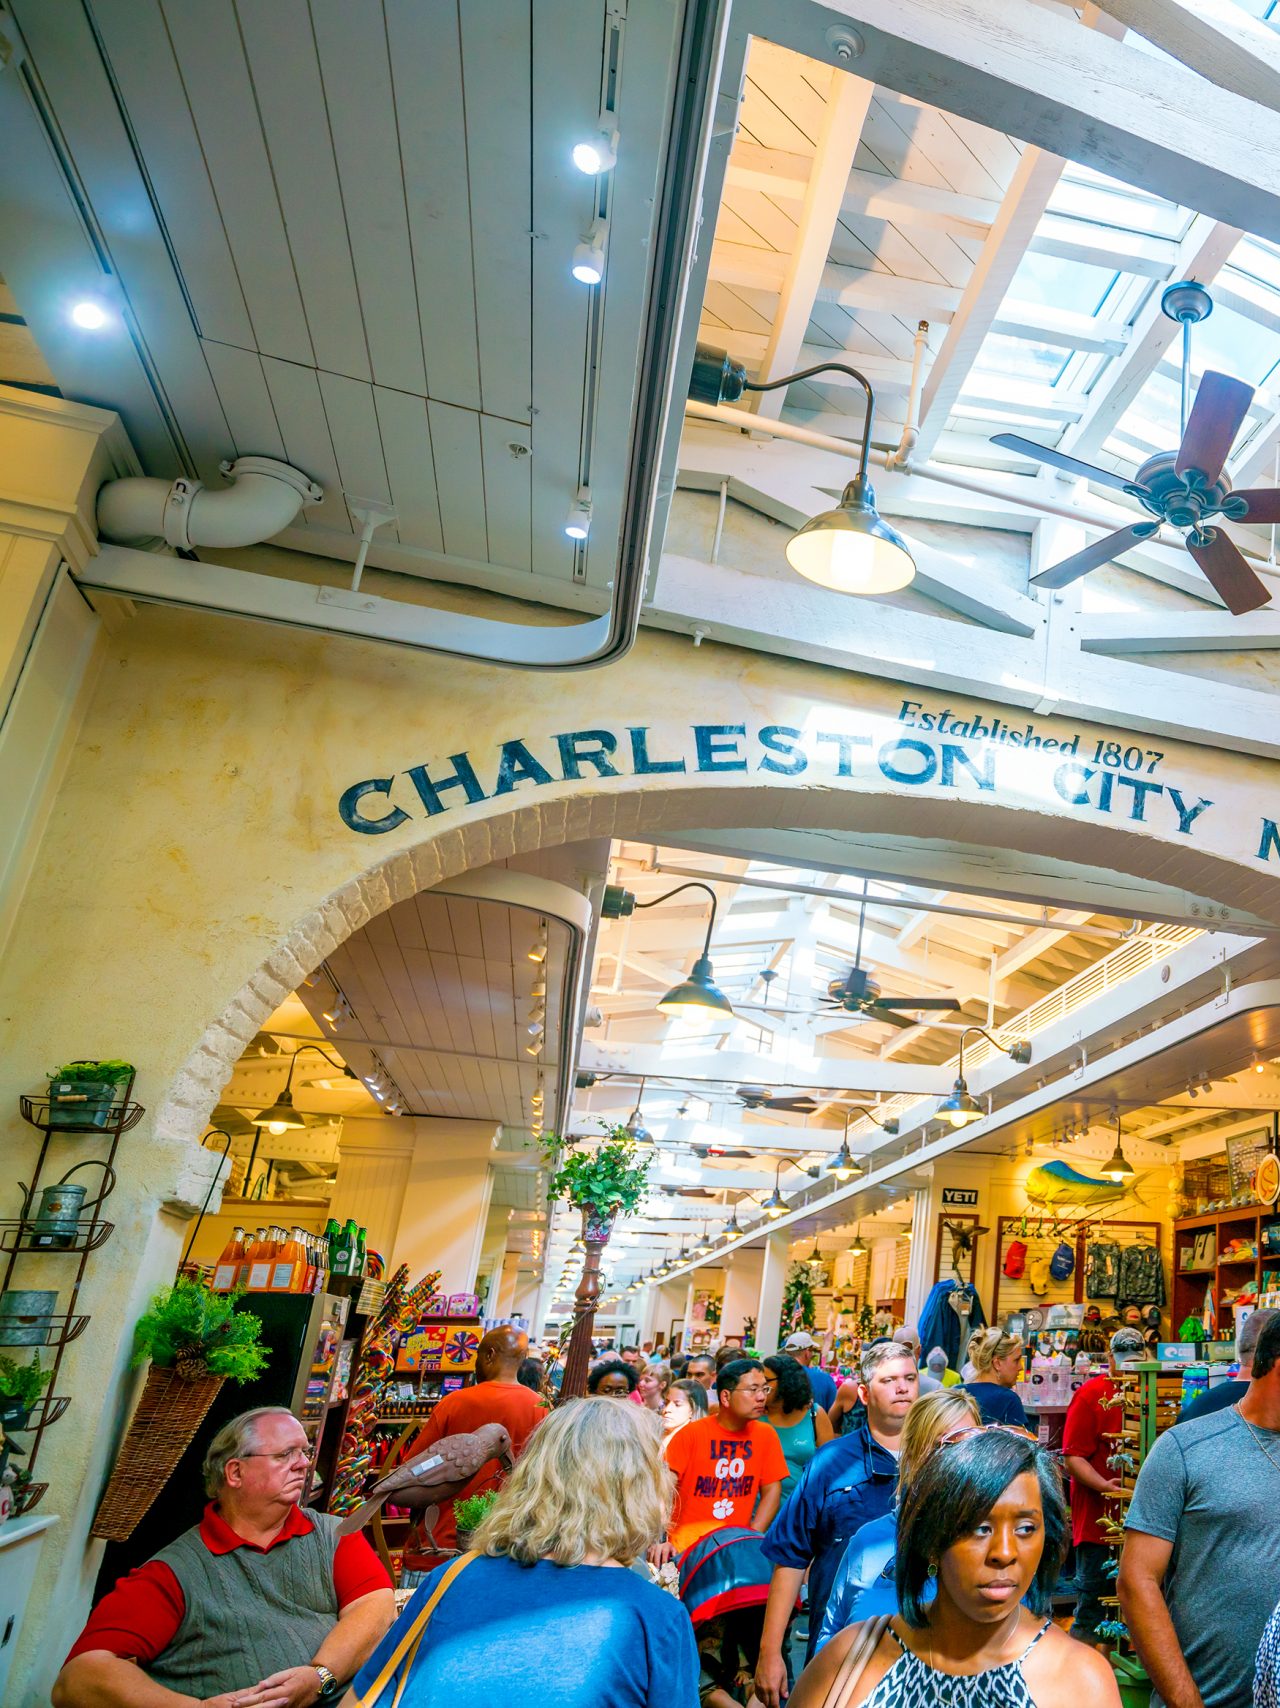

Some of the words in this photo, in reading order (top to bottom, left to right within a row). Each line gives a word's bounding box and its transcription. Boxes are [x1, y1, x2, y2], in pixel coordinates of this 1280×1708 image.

[898, 699, 1080, 759] Established
[1091, 738, 1165, 774] 1807
[337, 723, 998, 836] CHARLESTON
[1052, 761, 1215, 835] CITY
[944, 1190, 977, 1203] YETI
[710, 1439, 753, 1460] LET'S
[714, 1457, 746, 1480] GO
